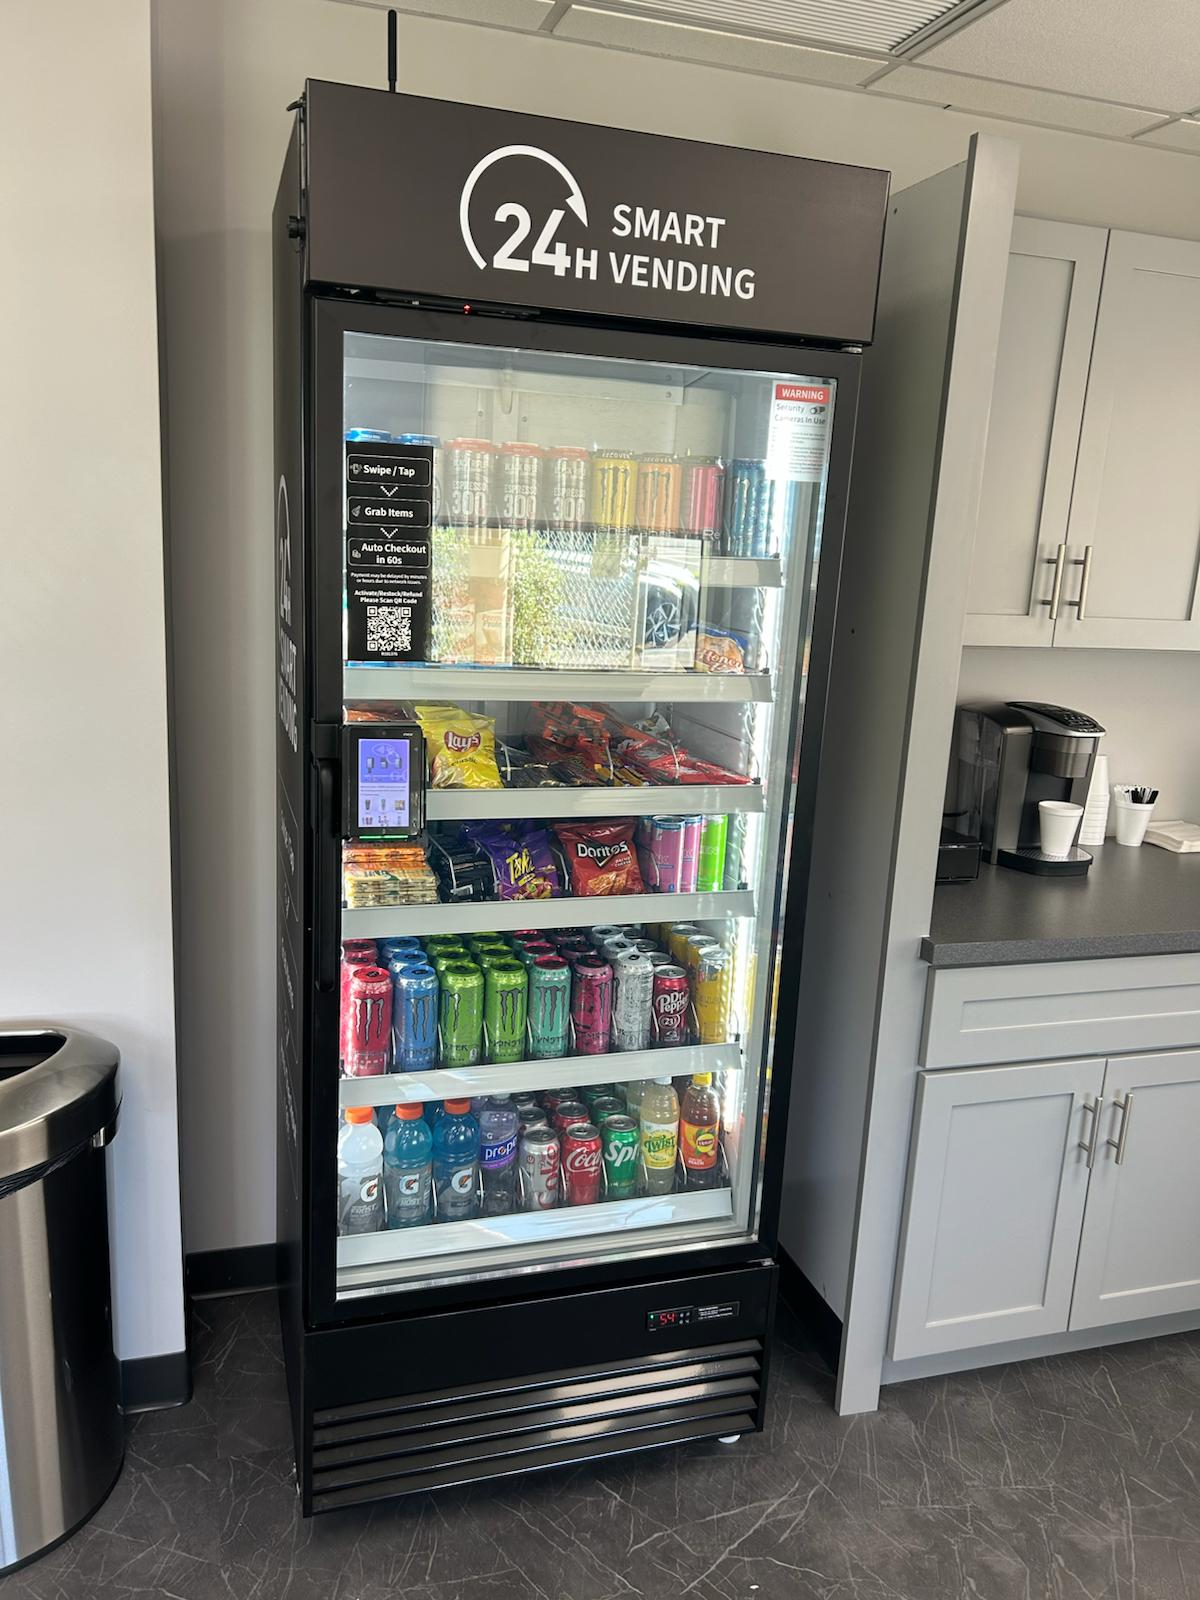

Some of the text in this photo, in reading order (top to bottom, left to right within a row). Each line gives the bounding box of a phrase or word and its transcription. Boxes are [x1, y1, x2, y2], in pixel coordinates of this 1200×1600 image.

[611, 203, 727, 249] SMART
[493, 202, 598, 281] 24H
[609, 251, 756, 300] VENDING
[781, 388, 824, 400] WARNING
[776, 402, 805, 413] Security
[813, 417, 826, 425] Use
[363, 464, 392, 476] Swipe
[398, 466, 416, 477] Tap
[452, 490, 486, 517] 300
[503, 493, 537, 519] 300
[552, 496, 586, 522] 300
[364, 507, 414, 518] Grab Items
[361, 543, 427, 554] Auto Checkout
[376, 555, 403, 565] in 60s
[577, 840, 629, 858] Doritos
[670, 991, 685, 1002] Dr
[644, 1134, 676, 1153] Twist
[659, 1312, 675, 1326] 54
